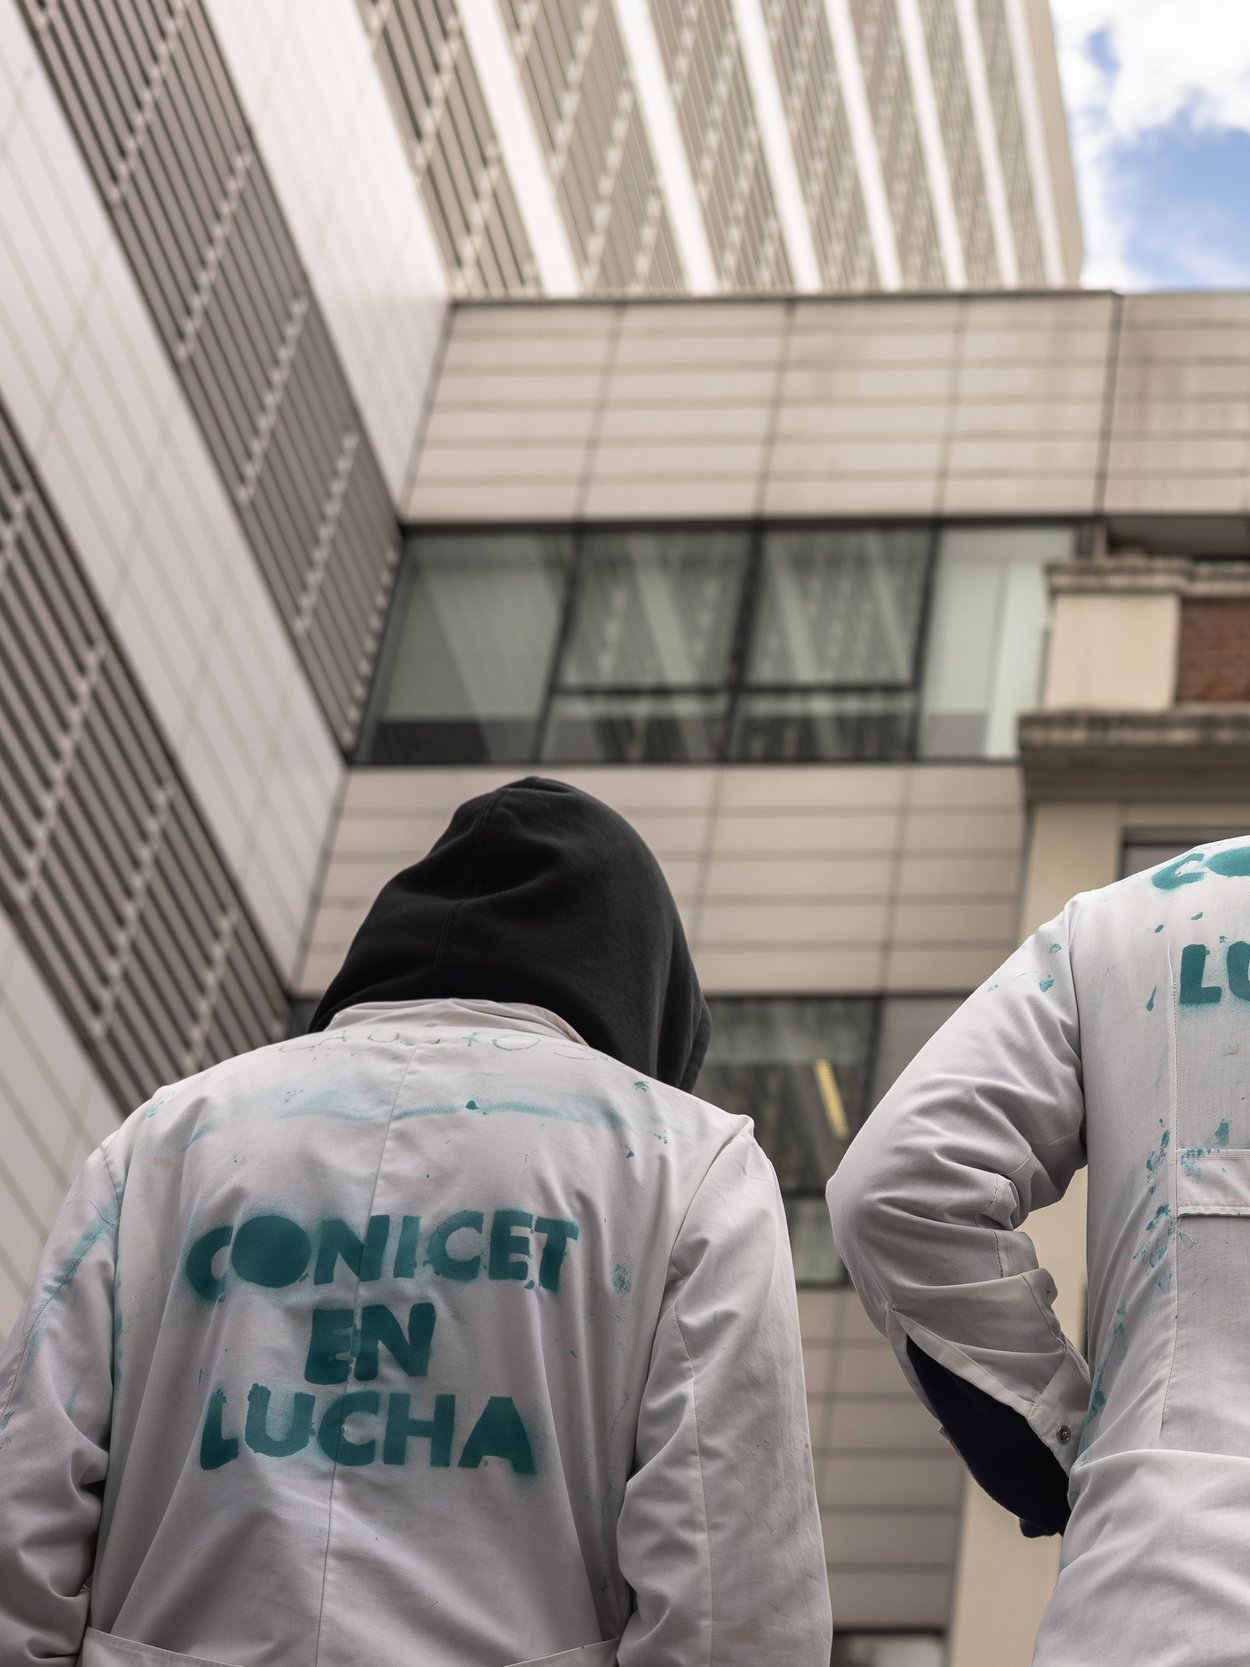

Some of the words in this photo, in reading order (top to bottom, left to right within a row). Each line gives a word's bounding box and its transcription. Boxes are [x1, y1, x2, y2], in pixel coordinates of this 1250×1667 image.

[187, 1210, 580, 1301] CONICET
[304, 1302, 437, 1384] EN
[201, 1384, 538, 1476] LUCHA
